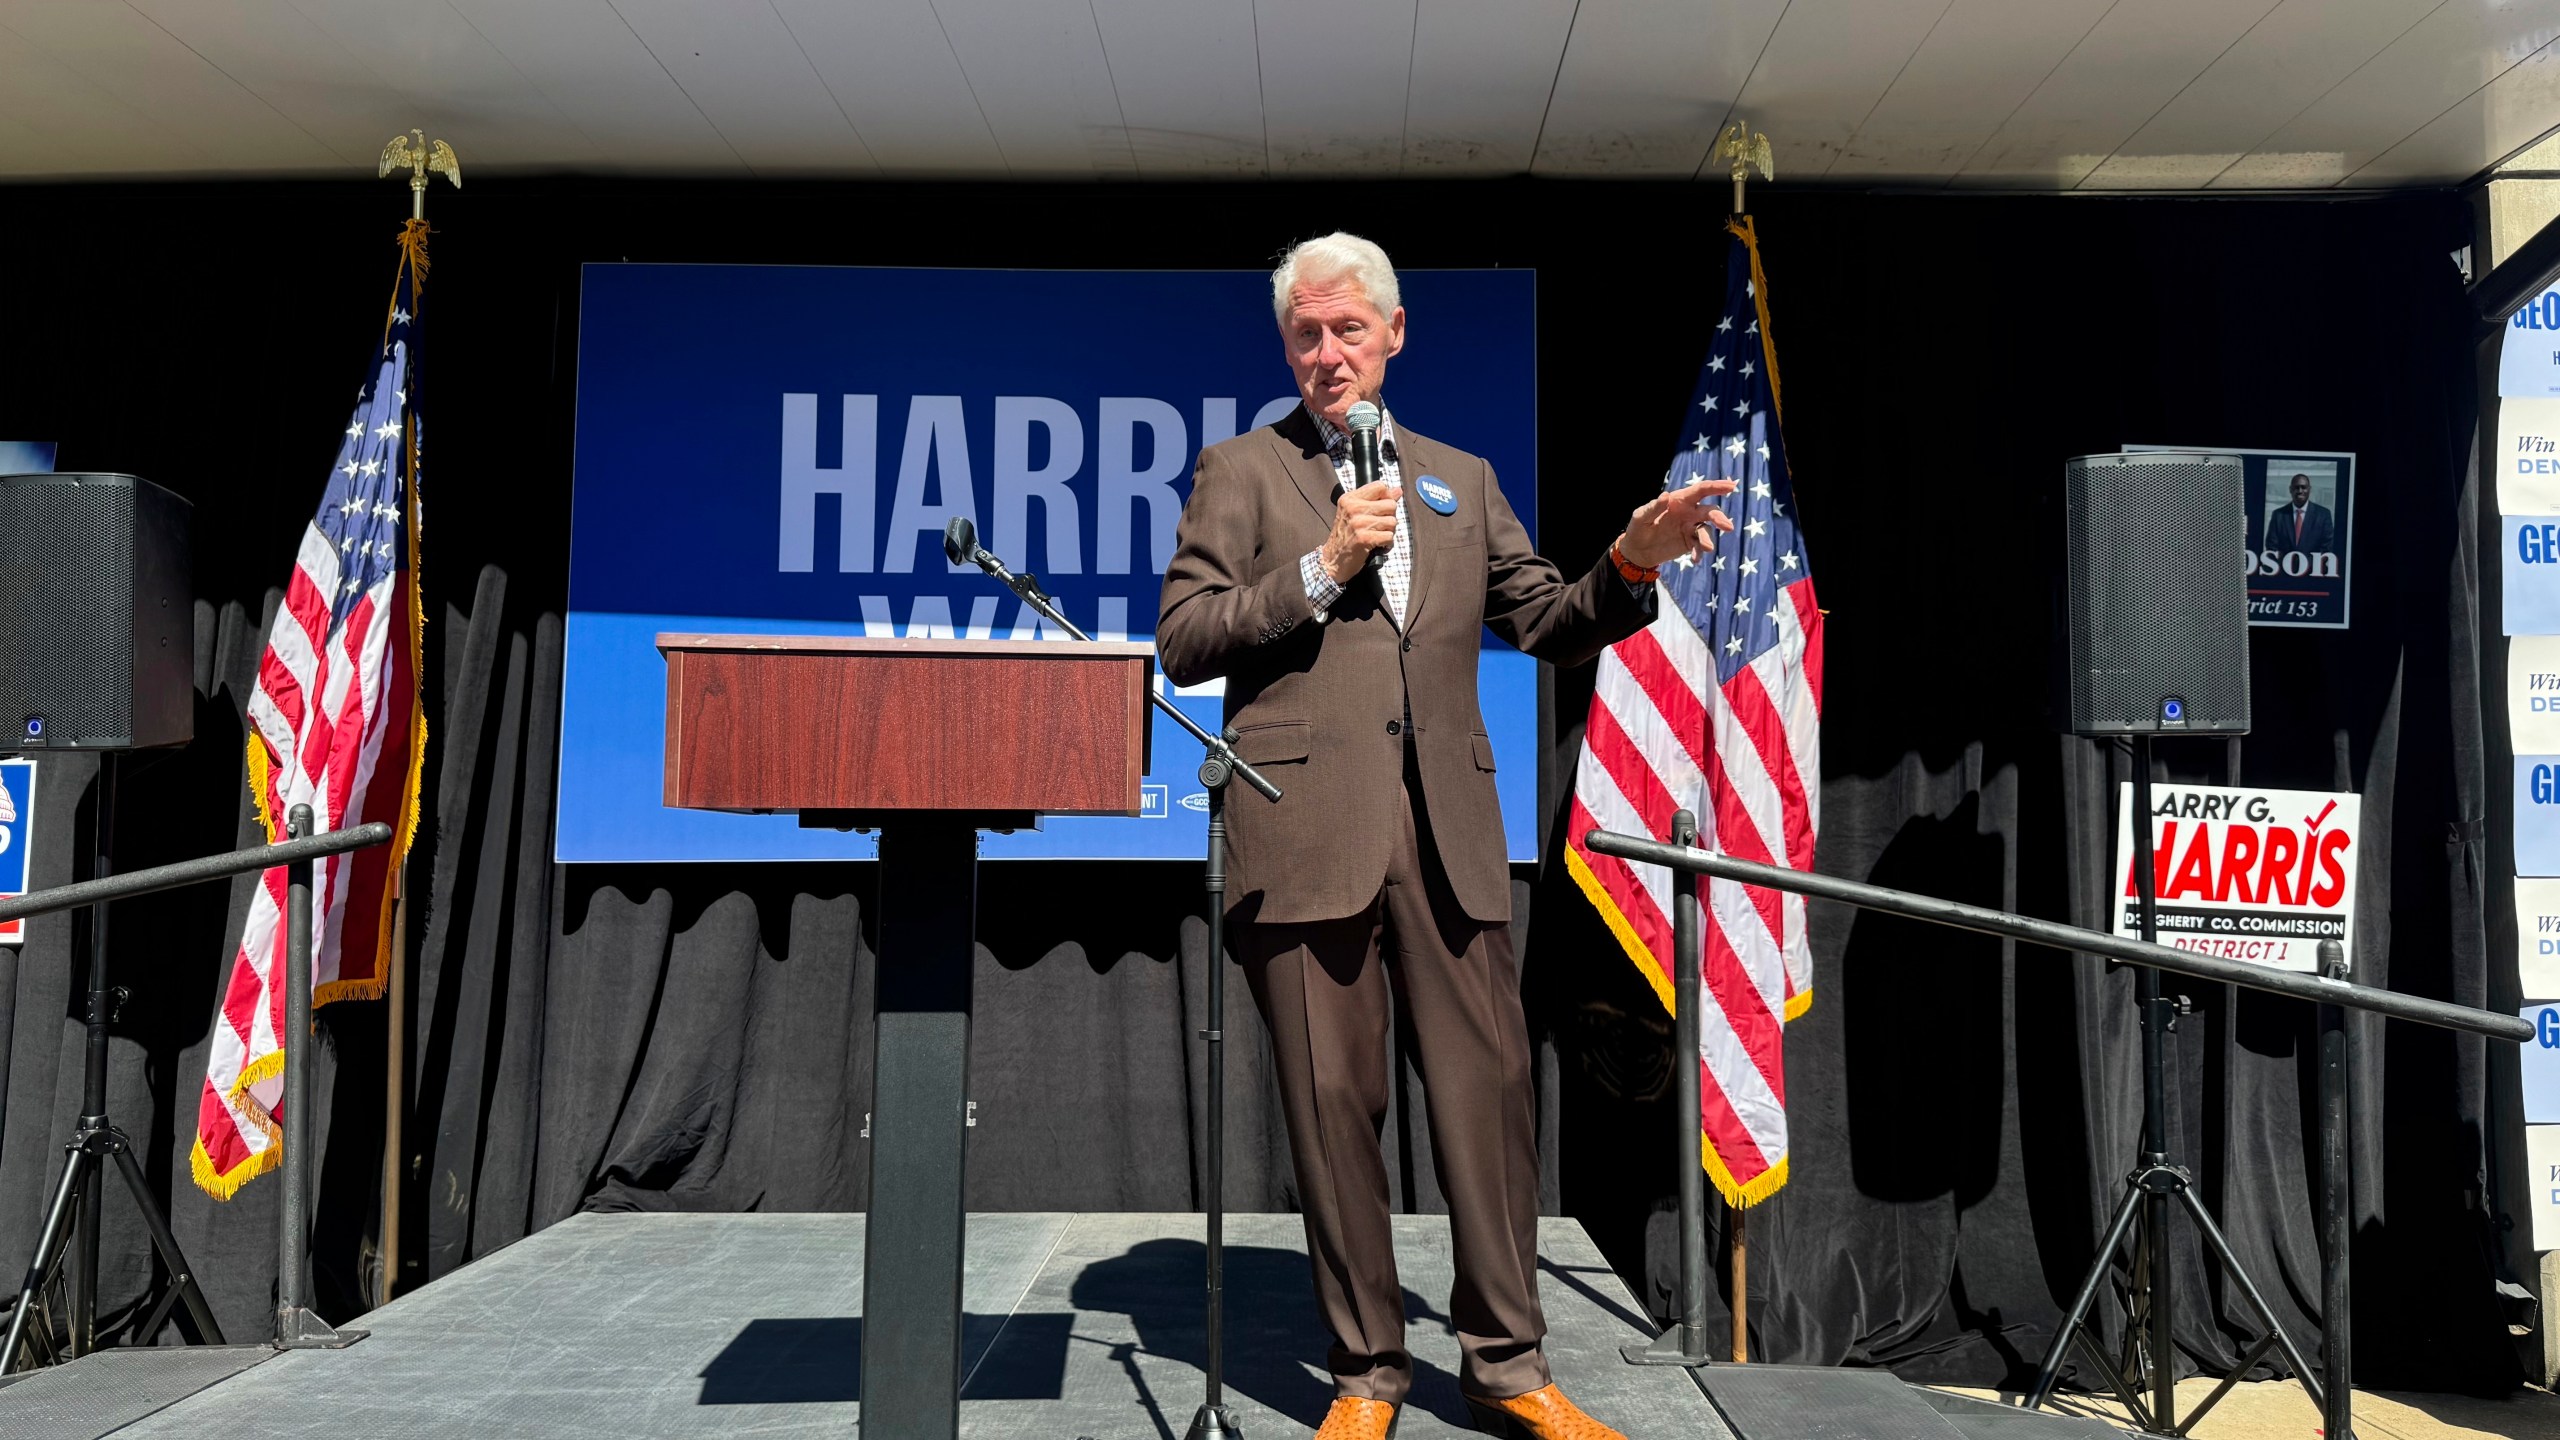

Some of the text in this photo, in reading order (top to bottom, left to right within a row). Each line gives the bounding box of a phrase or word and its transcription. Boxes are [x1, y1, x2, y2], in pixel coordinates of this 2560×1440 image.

[2518, 436, 2555, 452] Win
[779, 393, 1303, 575] HARR
[2518, 524, 2560, 564] GE
[2286, 602, 2318, 617] 153
[2152, 792, 2276, 824] ARRY G.
[2124, 912, 2344, 934] DGHERTY CO. COMMISSION
[2278, 942, 2289, 960] 1
